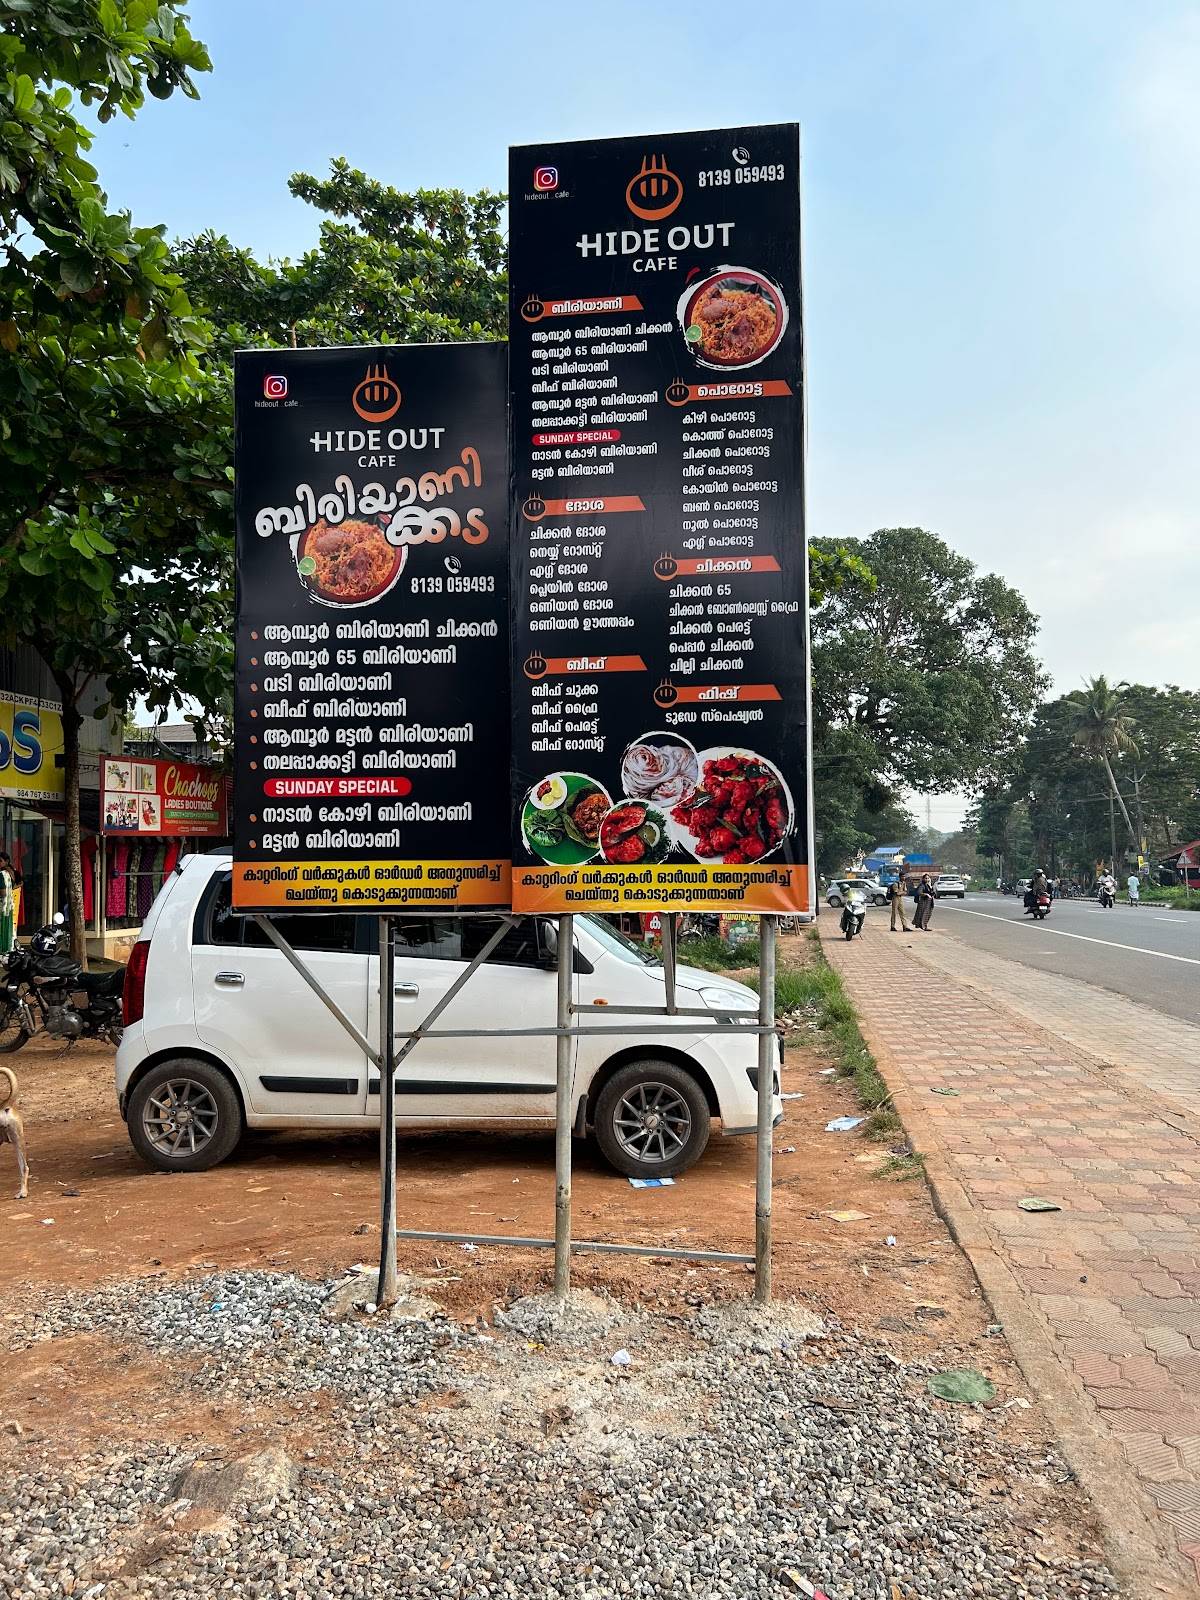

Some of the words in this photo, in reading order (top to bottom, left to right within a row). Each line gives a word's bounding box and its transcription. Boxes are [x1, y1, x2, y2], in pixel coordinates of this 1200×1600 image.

[699, 169, 730, 187] 8139
[735, 164, 784, 184] 059493
[576, 229, 659, 257] HIDE
[668, 223, 735, 250] OUT
[633, 257, 677, 272] CAFE
[575, 346, 587, 355] 65
[310, 429, 381, 452] HIDE
[388, 428, 445, 450] OUT
[540, 434, 574, 443] SUNDAY
[577, 432, 613, 441] SPECIAL
[358, 456, 396, 467] CAFE
[411, 577, 442, 593] 8139
[447, 576, 495, 592] 059493
[717, 584, 731, 595] 65
[337, 650, 356, 665] 65
[275, 781, 334, 794] SUNDAY
[339, 780, 399, 793] SPECIAL
[164, 799, 185, 809] LADIES
[185, 800, 213, 811] BOUTIQUE
